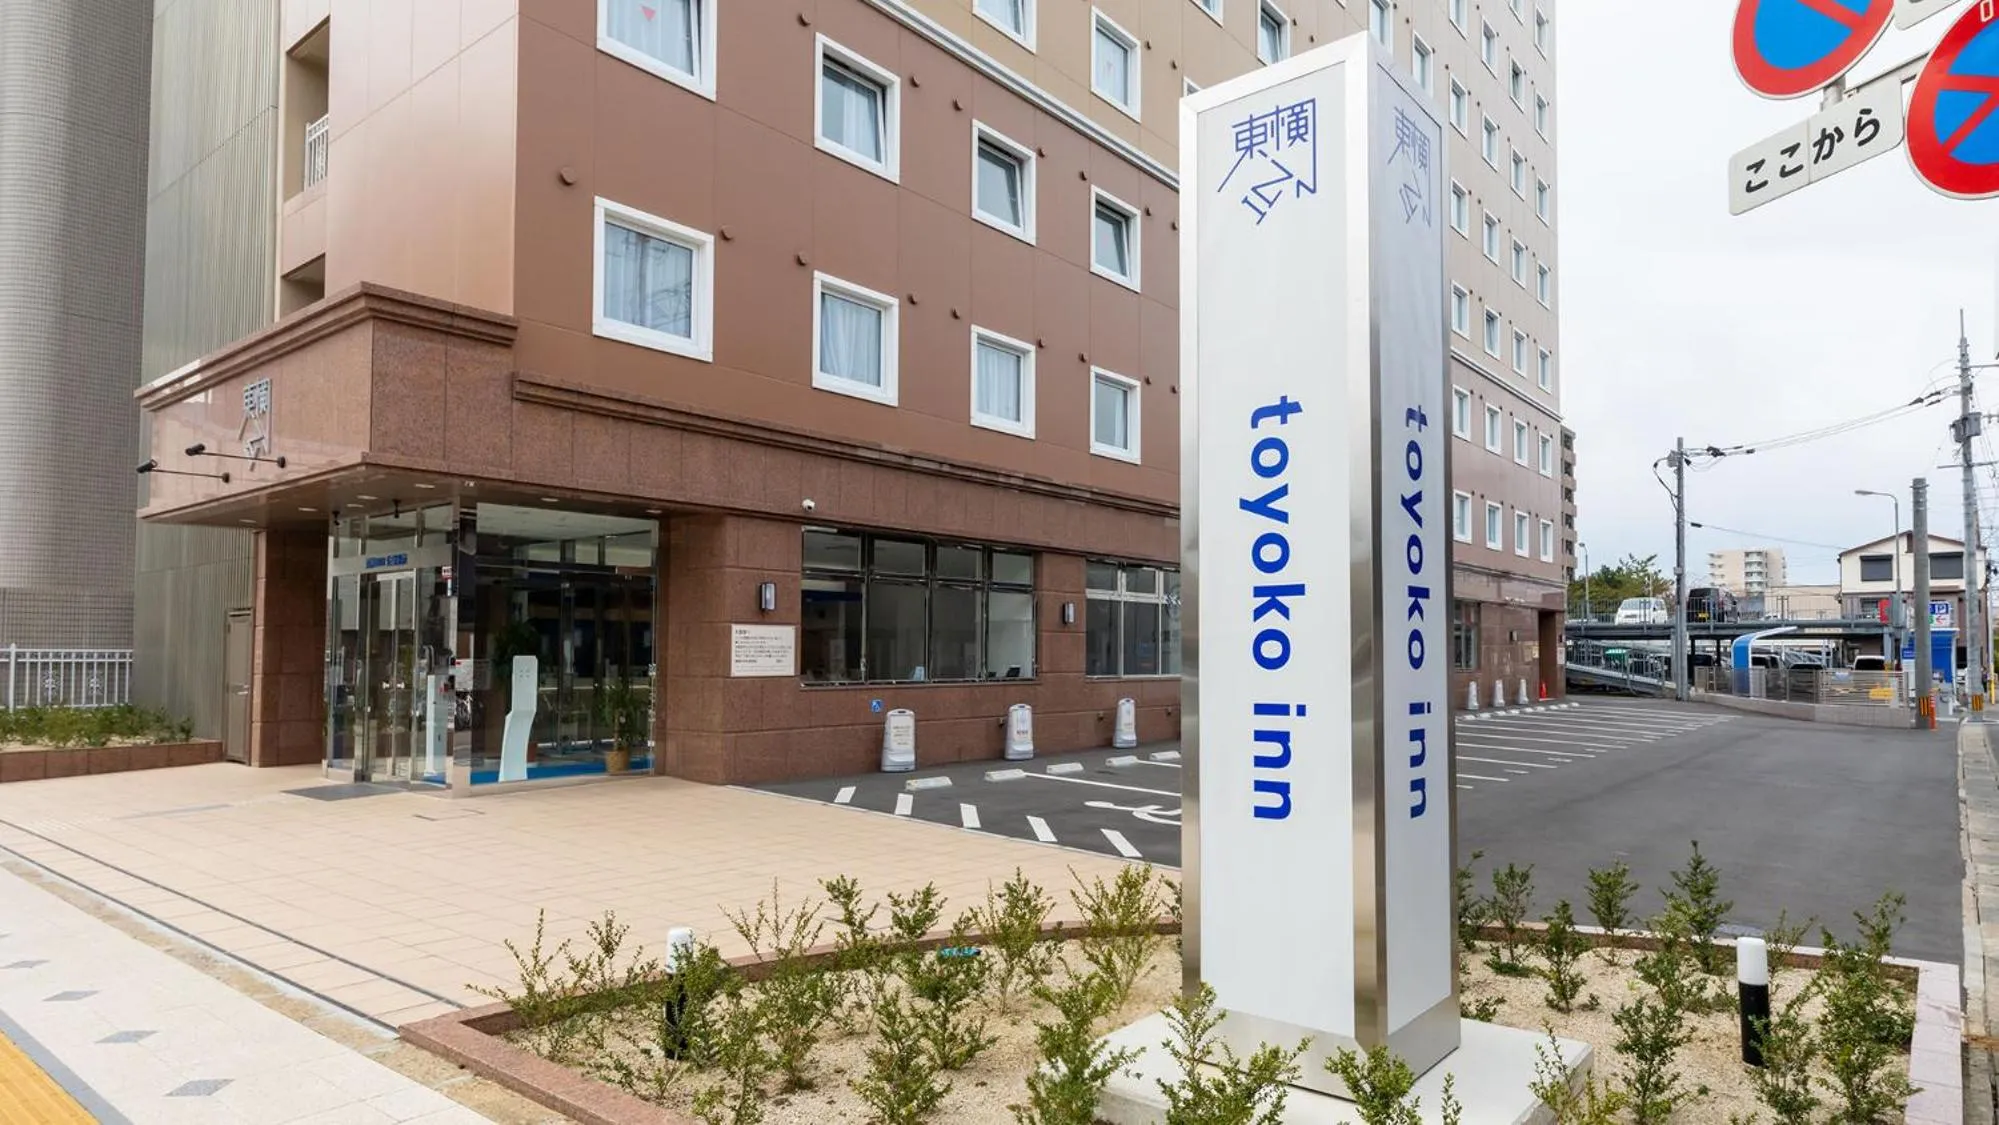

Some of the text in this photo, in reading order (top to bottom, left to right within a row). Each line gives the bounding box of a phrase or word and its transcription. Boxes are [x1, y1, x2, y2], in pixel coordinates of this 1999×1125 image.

[1744, 108, 1881, 194] ここから
[1239, 395, 1307, 820] toyoko inn
[1400, 404, 1432, 820] toyoko inn
